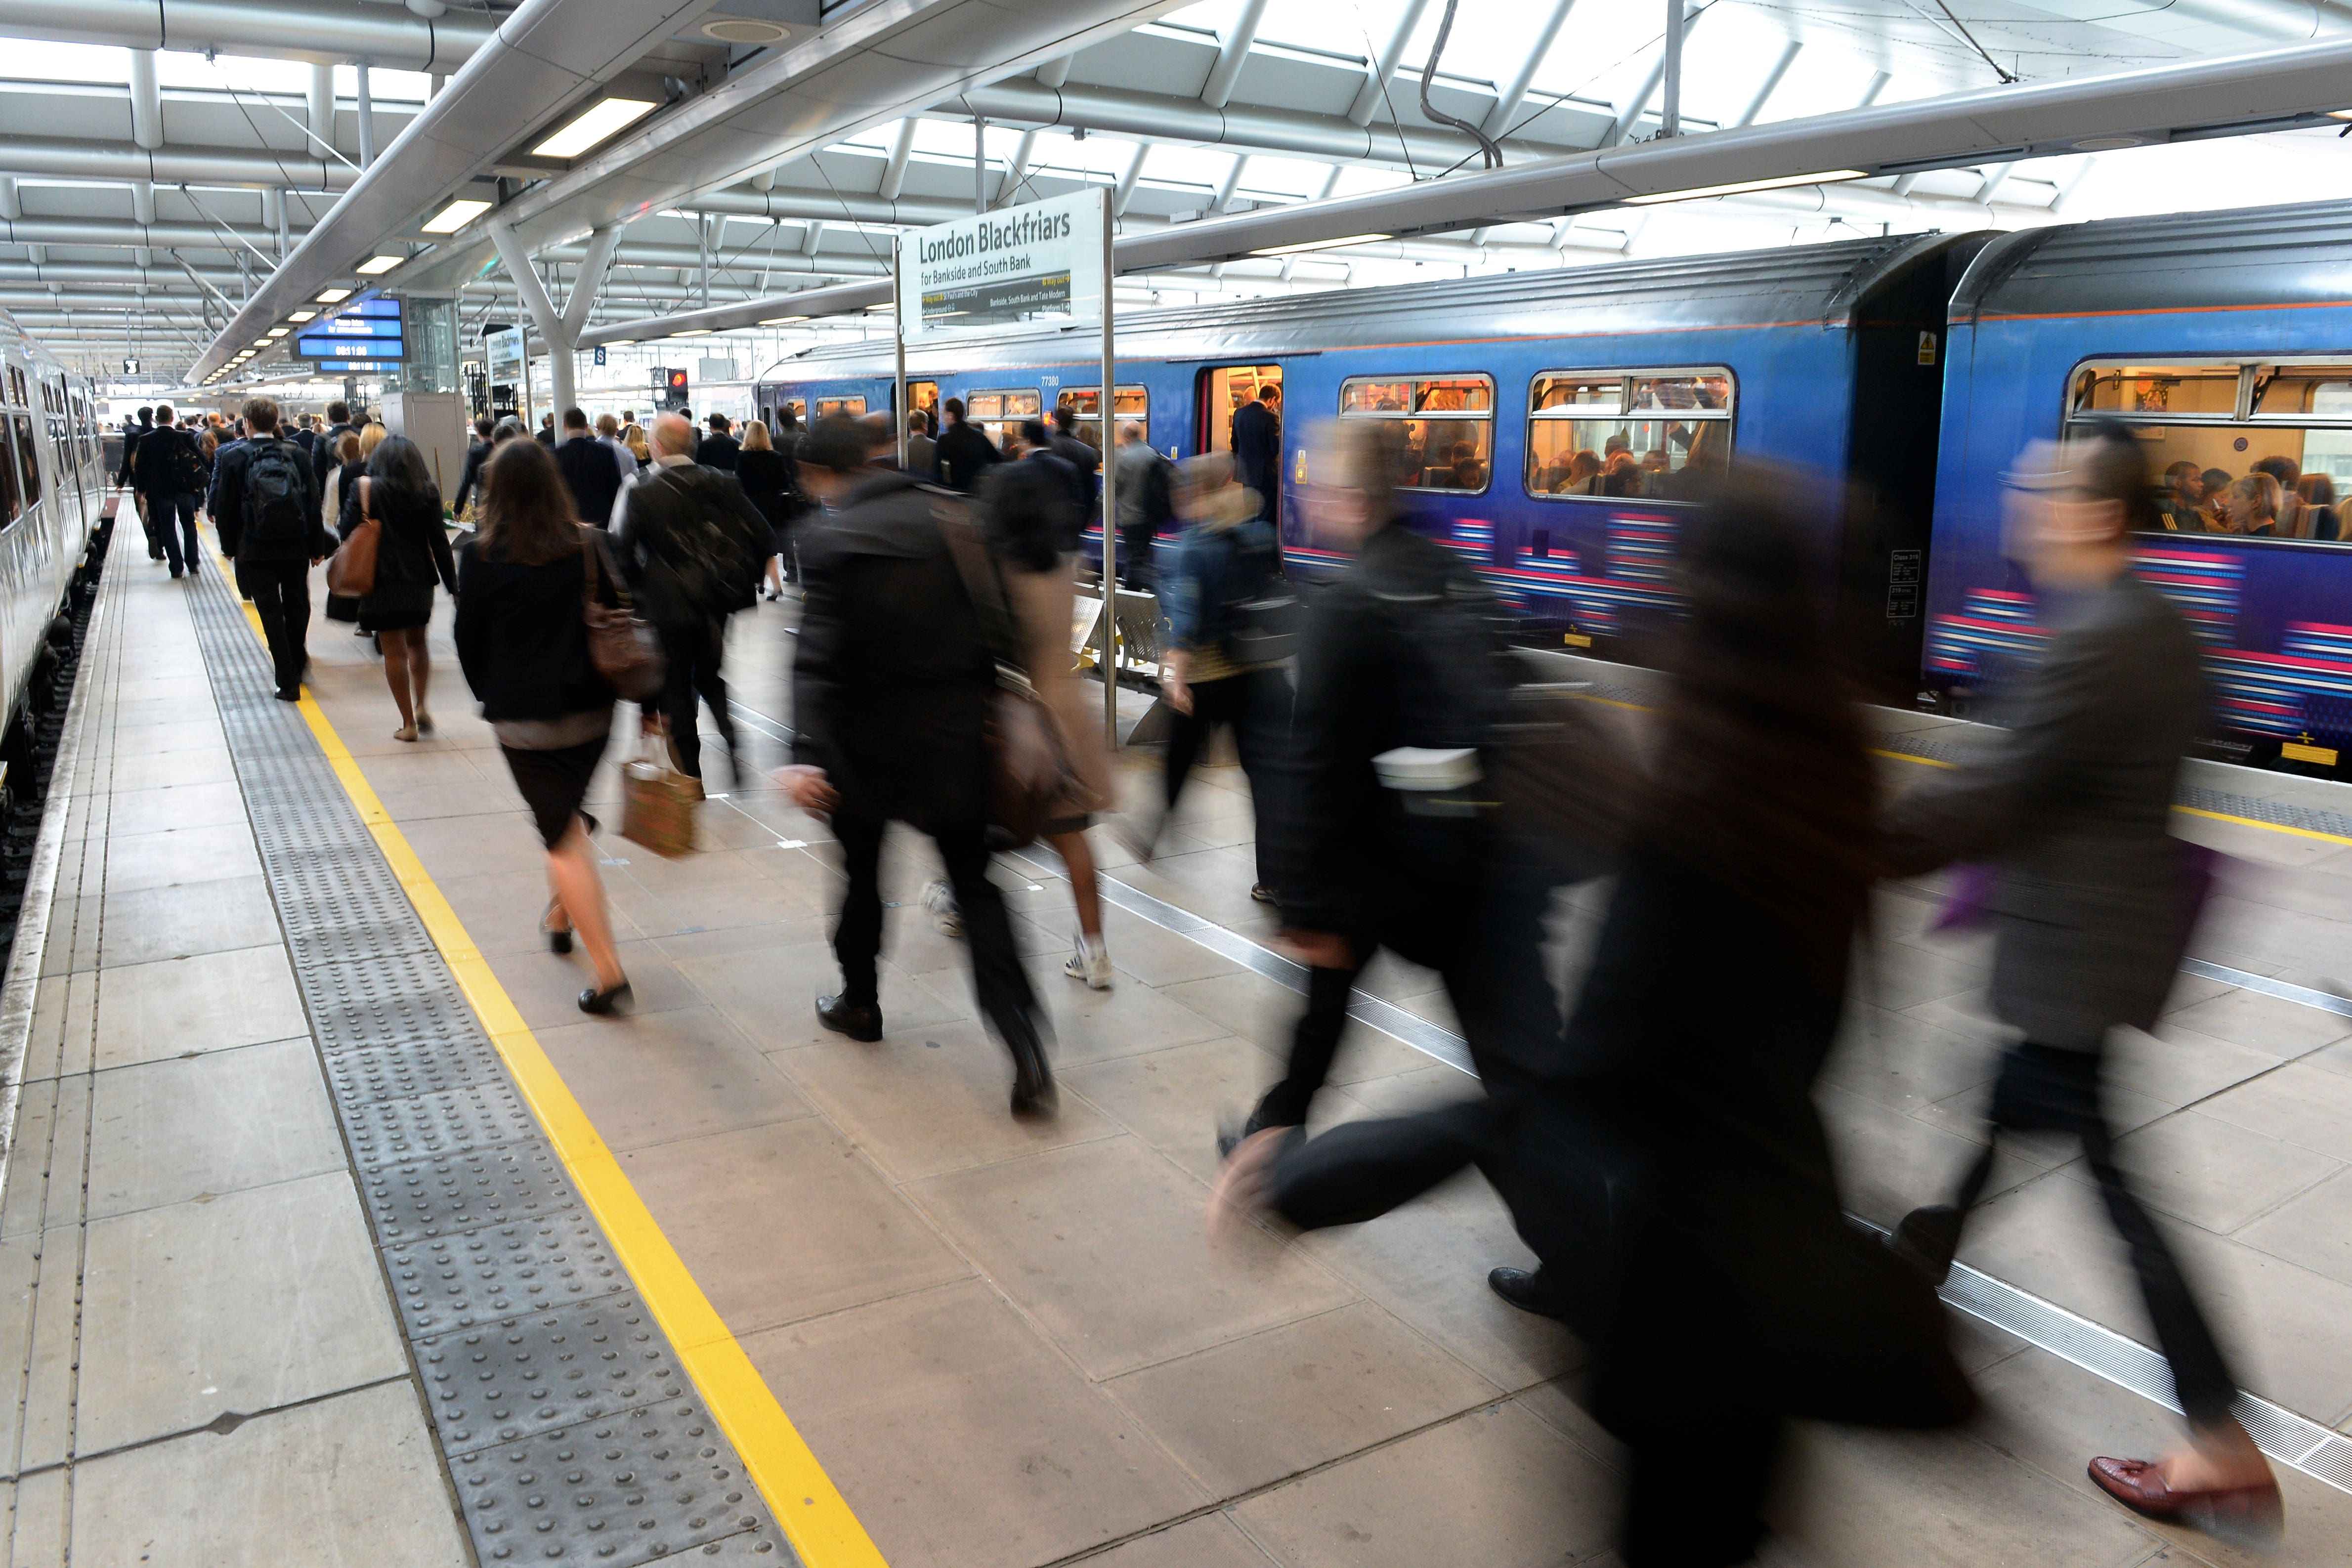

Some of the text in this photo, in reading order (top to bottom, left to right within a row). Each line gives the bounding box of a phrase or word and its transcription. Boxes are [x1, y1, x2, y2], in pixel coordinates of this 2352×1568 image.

[920, 210, 1070, 264] London Blackfriars
[921, 253, 1030, 286] for Bankside and South Bank
[1047, 277, 1056, 286] Way
[990, 297, 1008, 307] Bankside,
[1008, 296, 1020, 304] South
[1021, 294, 1030, 302] Bank
[1039, 291, 1048, 300] Tate
[1049, 289, 1065, 298] Modern
[926, 305, 947, 315] Underground
[1042, 302, 1064, 312] Platform 1
[598, 350, 603, 363] S
[1041, 376, 1059, 386] 77380
